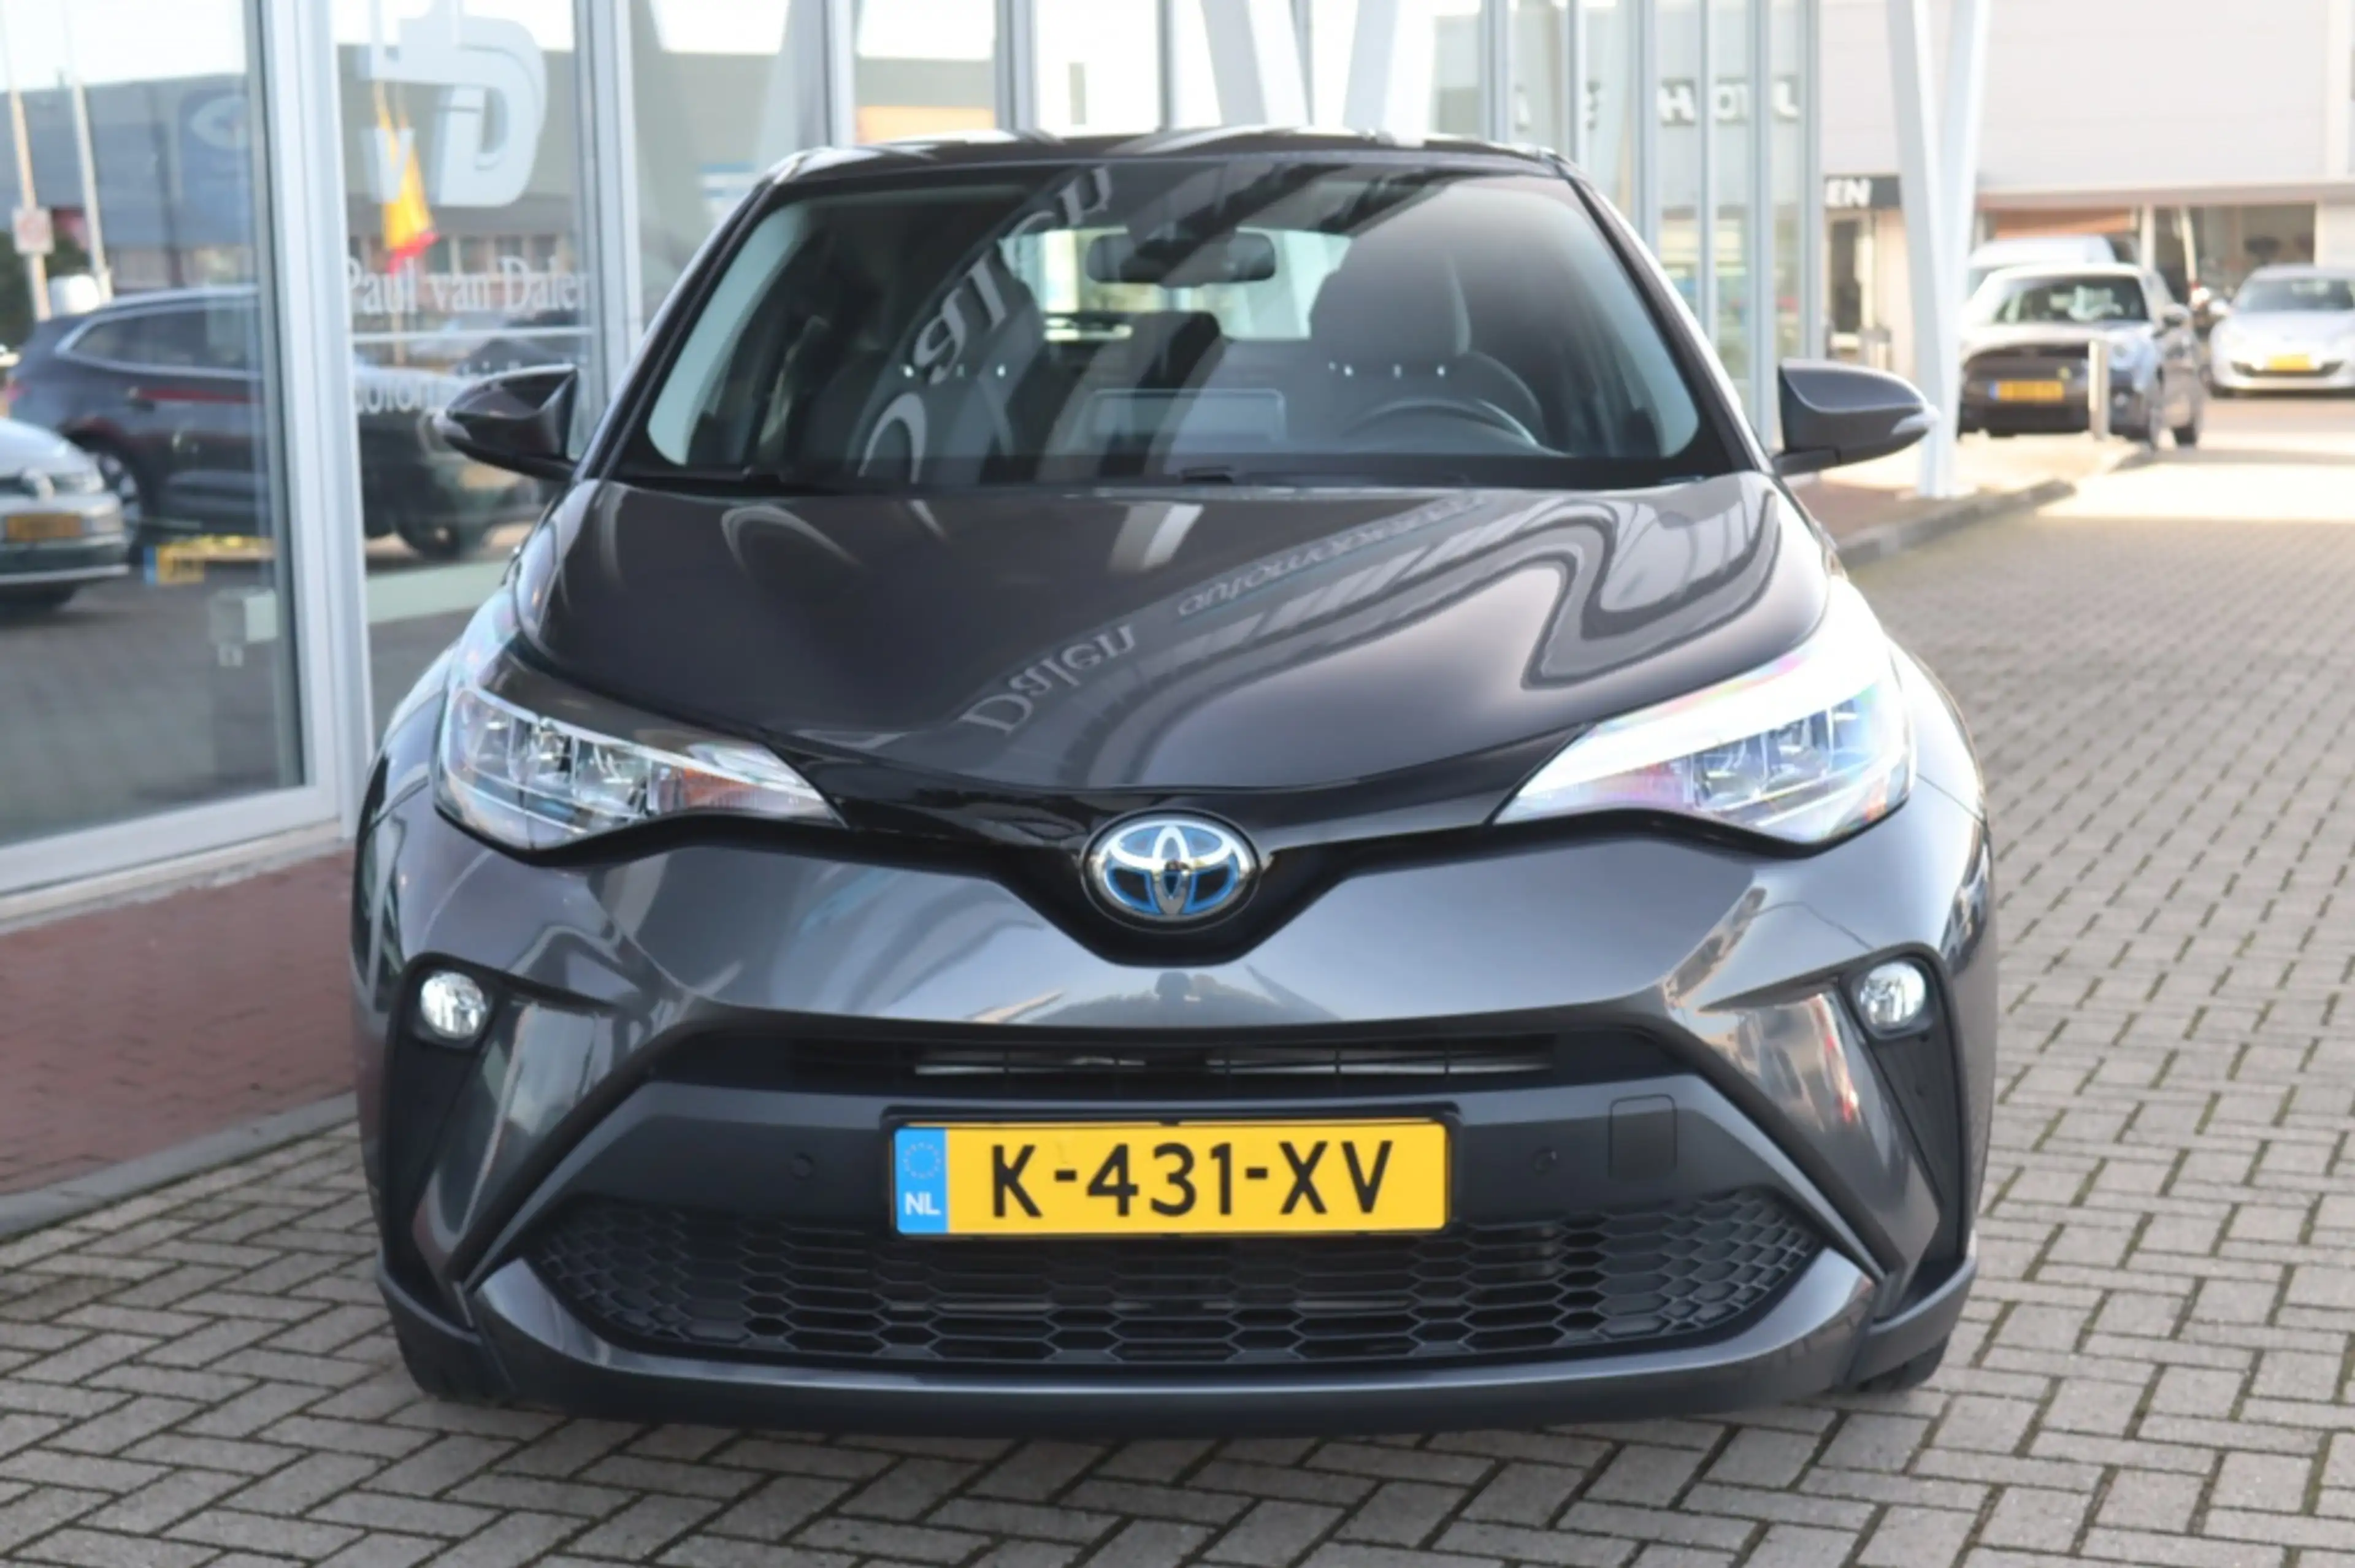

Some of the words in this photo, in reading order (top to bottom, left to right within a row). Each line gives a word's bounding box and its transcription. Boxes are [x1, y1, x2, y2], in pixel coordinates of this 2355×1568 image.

[347, 255, 418, 315] Paul
[429, 272, 491, 312] van
[904, 1191, 941, 1217] NL
[991, 1139, 1393, 1218] K-431-XV
